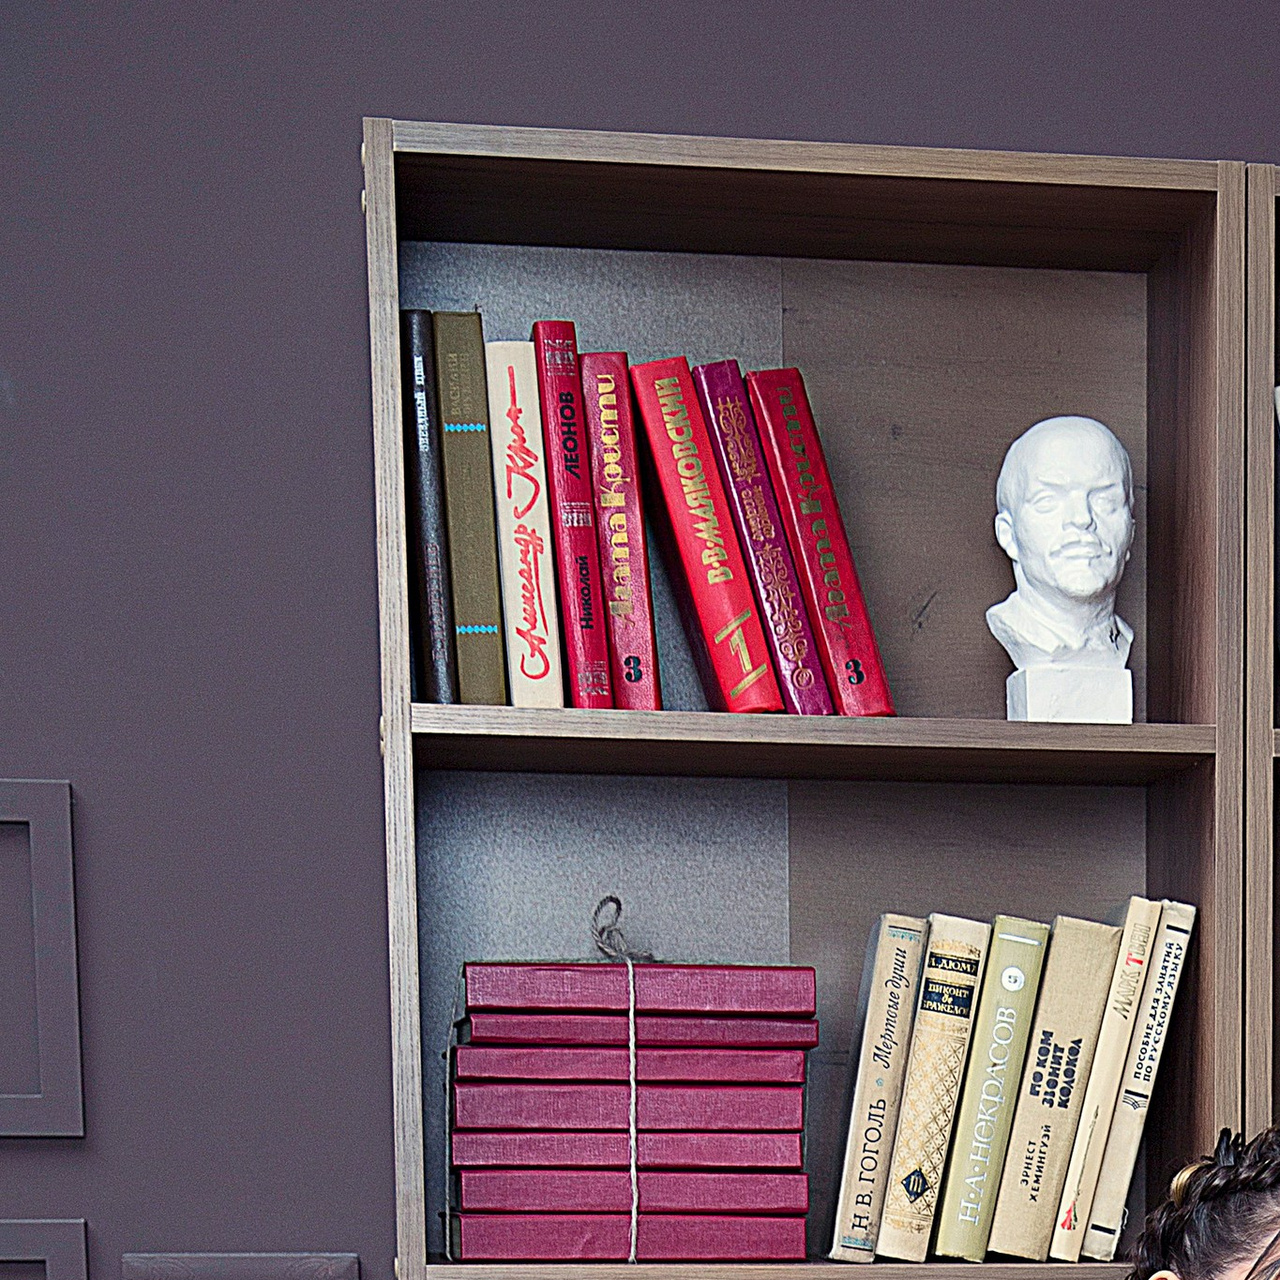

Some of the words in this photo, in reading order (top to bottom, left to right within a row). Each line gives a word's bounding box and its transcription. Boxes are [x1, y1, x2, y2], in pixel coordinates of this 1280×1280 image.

[559, 391, 581, 480] ЛЕОНОВ
[596, 374, 631, 508] Кристи
[774, 386, 825, 515] Кристи
[575, 554, 595, 630] Николай
[608, 512, 636, 628] Агата
[810, 518, 854, 633] Агата
[624, 655, 643, 682] 3
[845, 658, 866, 685] 3
[885, 947, 911, 988] души
[1126, 925, 1151, 967] ТВЕН
[1113, 970, 1141, 1020] МАРК
[1133, 1022, 1154, 1080] ПОСОБИЕ
[1148, 998, 1161, 1022] ДЛЯ
[1155, 941, 1175, 996] ЗАНЯТИЙ
[1142, 1066, 1152, 1082] ПО
[1148, 992, 1172, 1063] РУССКОМУ
[1167, 942, 1184, 991] ЯЗЫКУ
[1029, 1071, 1044, 1098] ПО
[1035, 1030, 1054, 1069] КОМ
[1042, 1042, 1066, 1109] ЗВОНИТ
[1057, 1037, 1083, 1110] КОЛОКОЛ
[859, 1098, 887, 1184] ГОГОЛЬ
[1020, 1140, 1037, 1186] ЭРНЕСТ
[1029, 1124, 1052, 1203] ХЕМИНГУЭЙ
